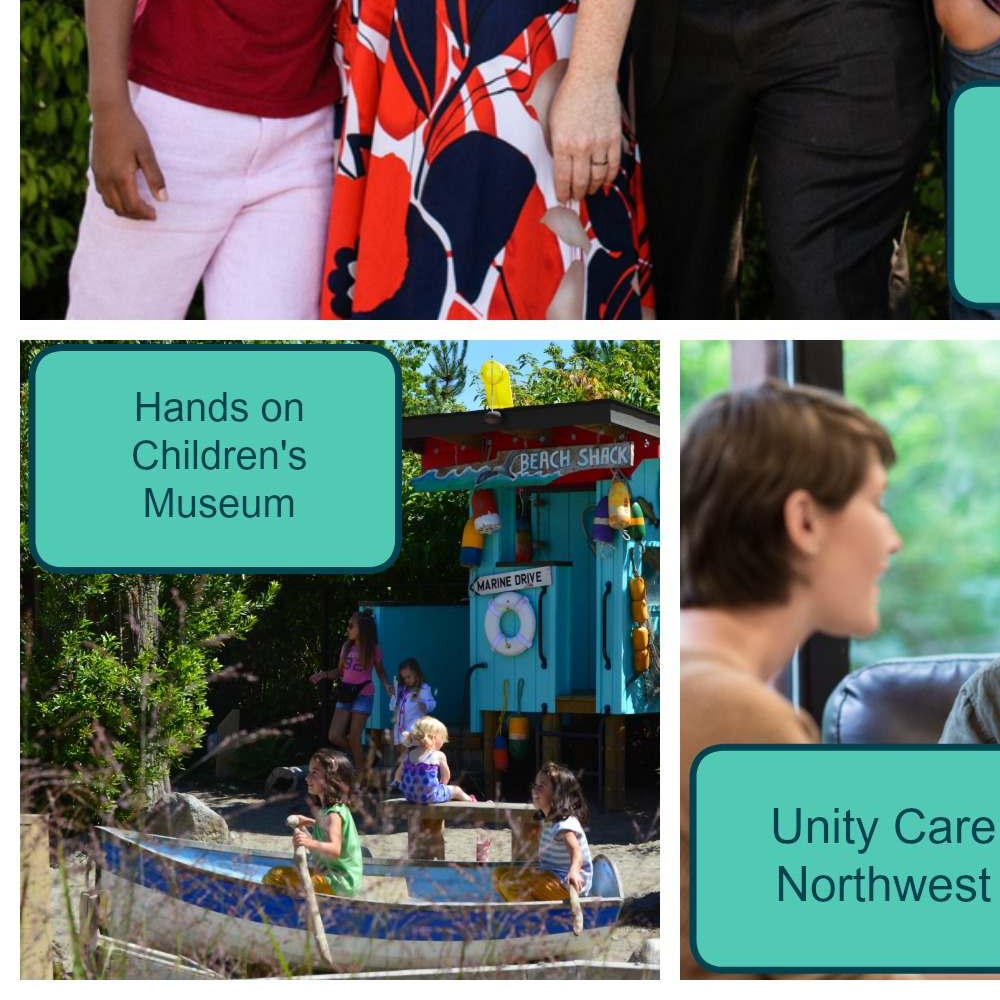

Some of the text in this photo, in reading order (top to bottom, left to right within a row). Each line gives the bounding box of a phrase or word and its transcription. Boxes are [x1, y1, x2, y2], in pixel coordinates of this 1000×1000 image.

[520, 445, 628, 473] BEACH SHACK
[477, 571, 542, 592] MARINE DRIVE
